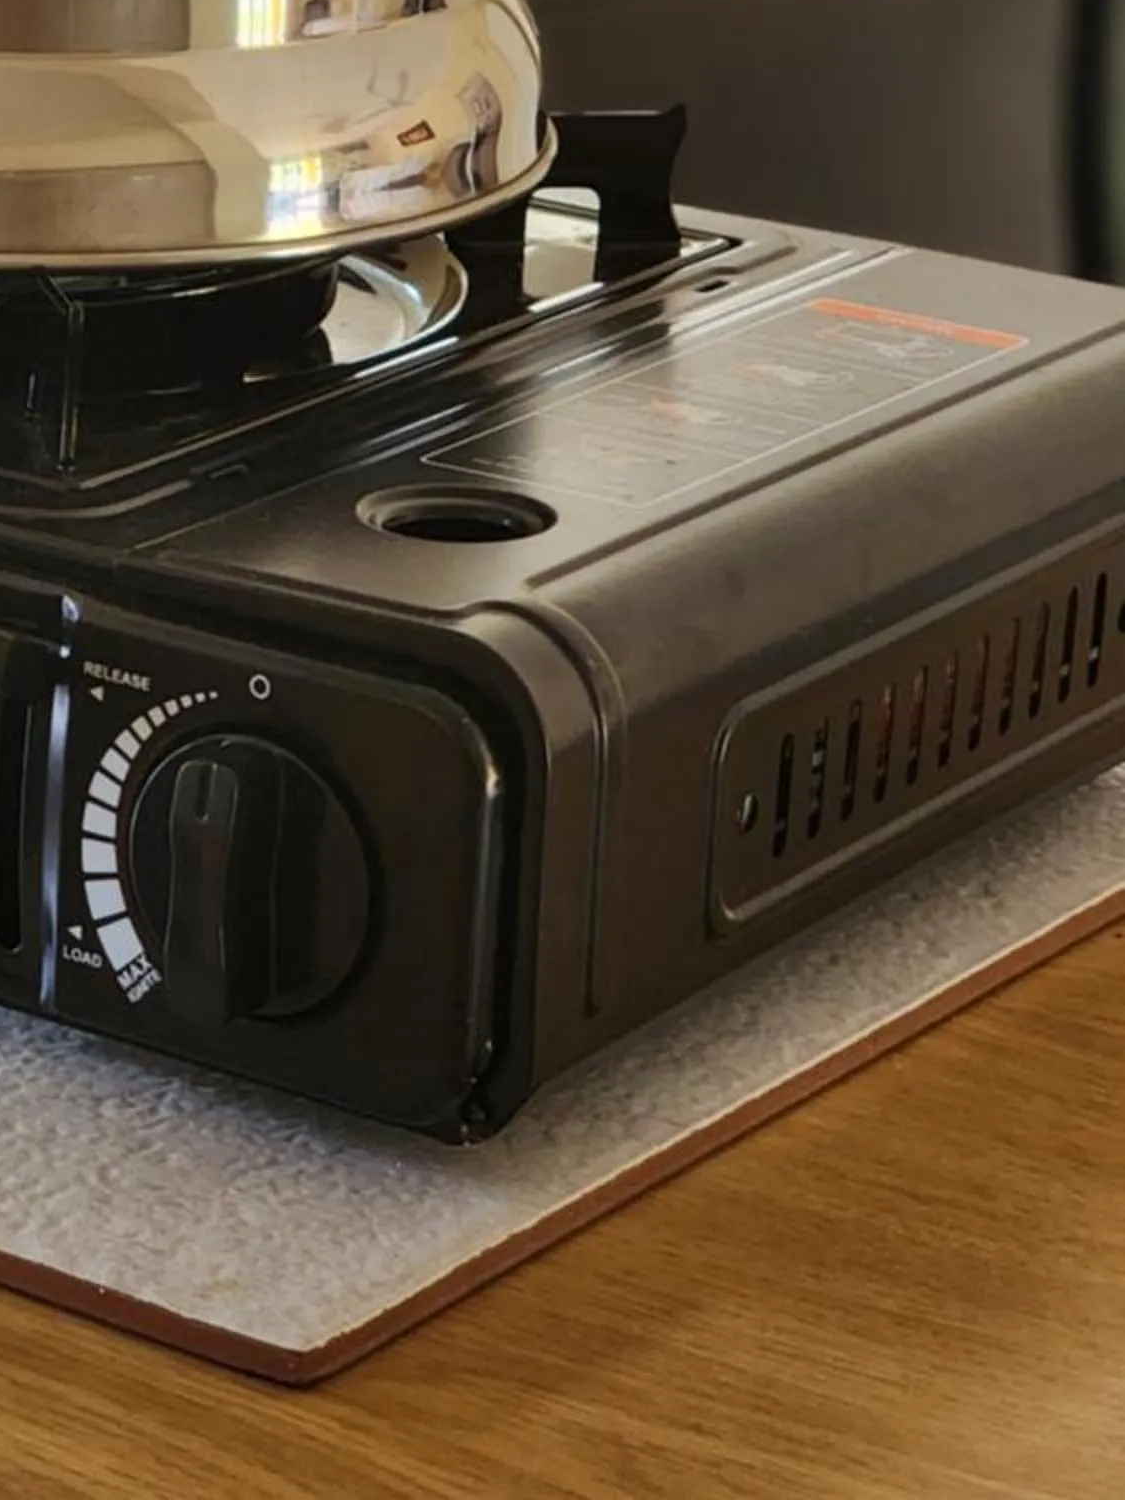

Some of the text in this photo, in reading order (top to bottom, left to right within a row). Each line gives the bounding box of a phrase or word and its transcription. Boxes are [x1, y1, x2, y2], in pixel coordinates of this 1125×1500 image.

[83, 660, 151, 692] RELEASE
[61, 944, 103, 969] LOAD
[116, 953, 153, 991] MAX
